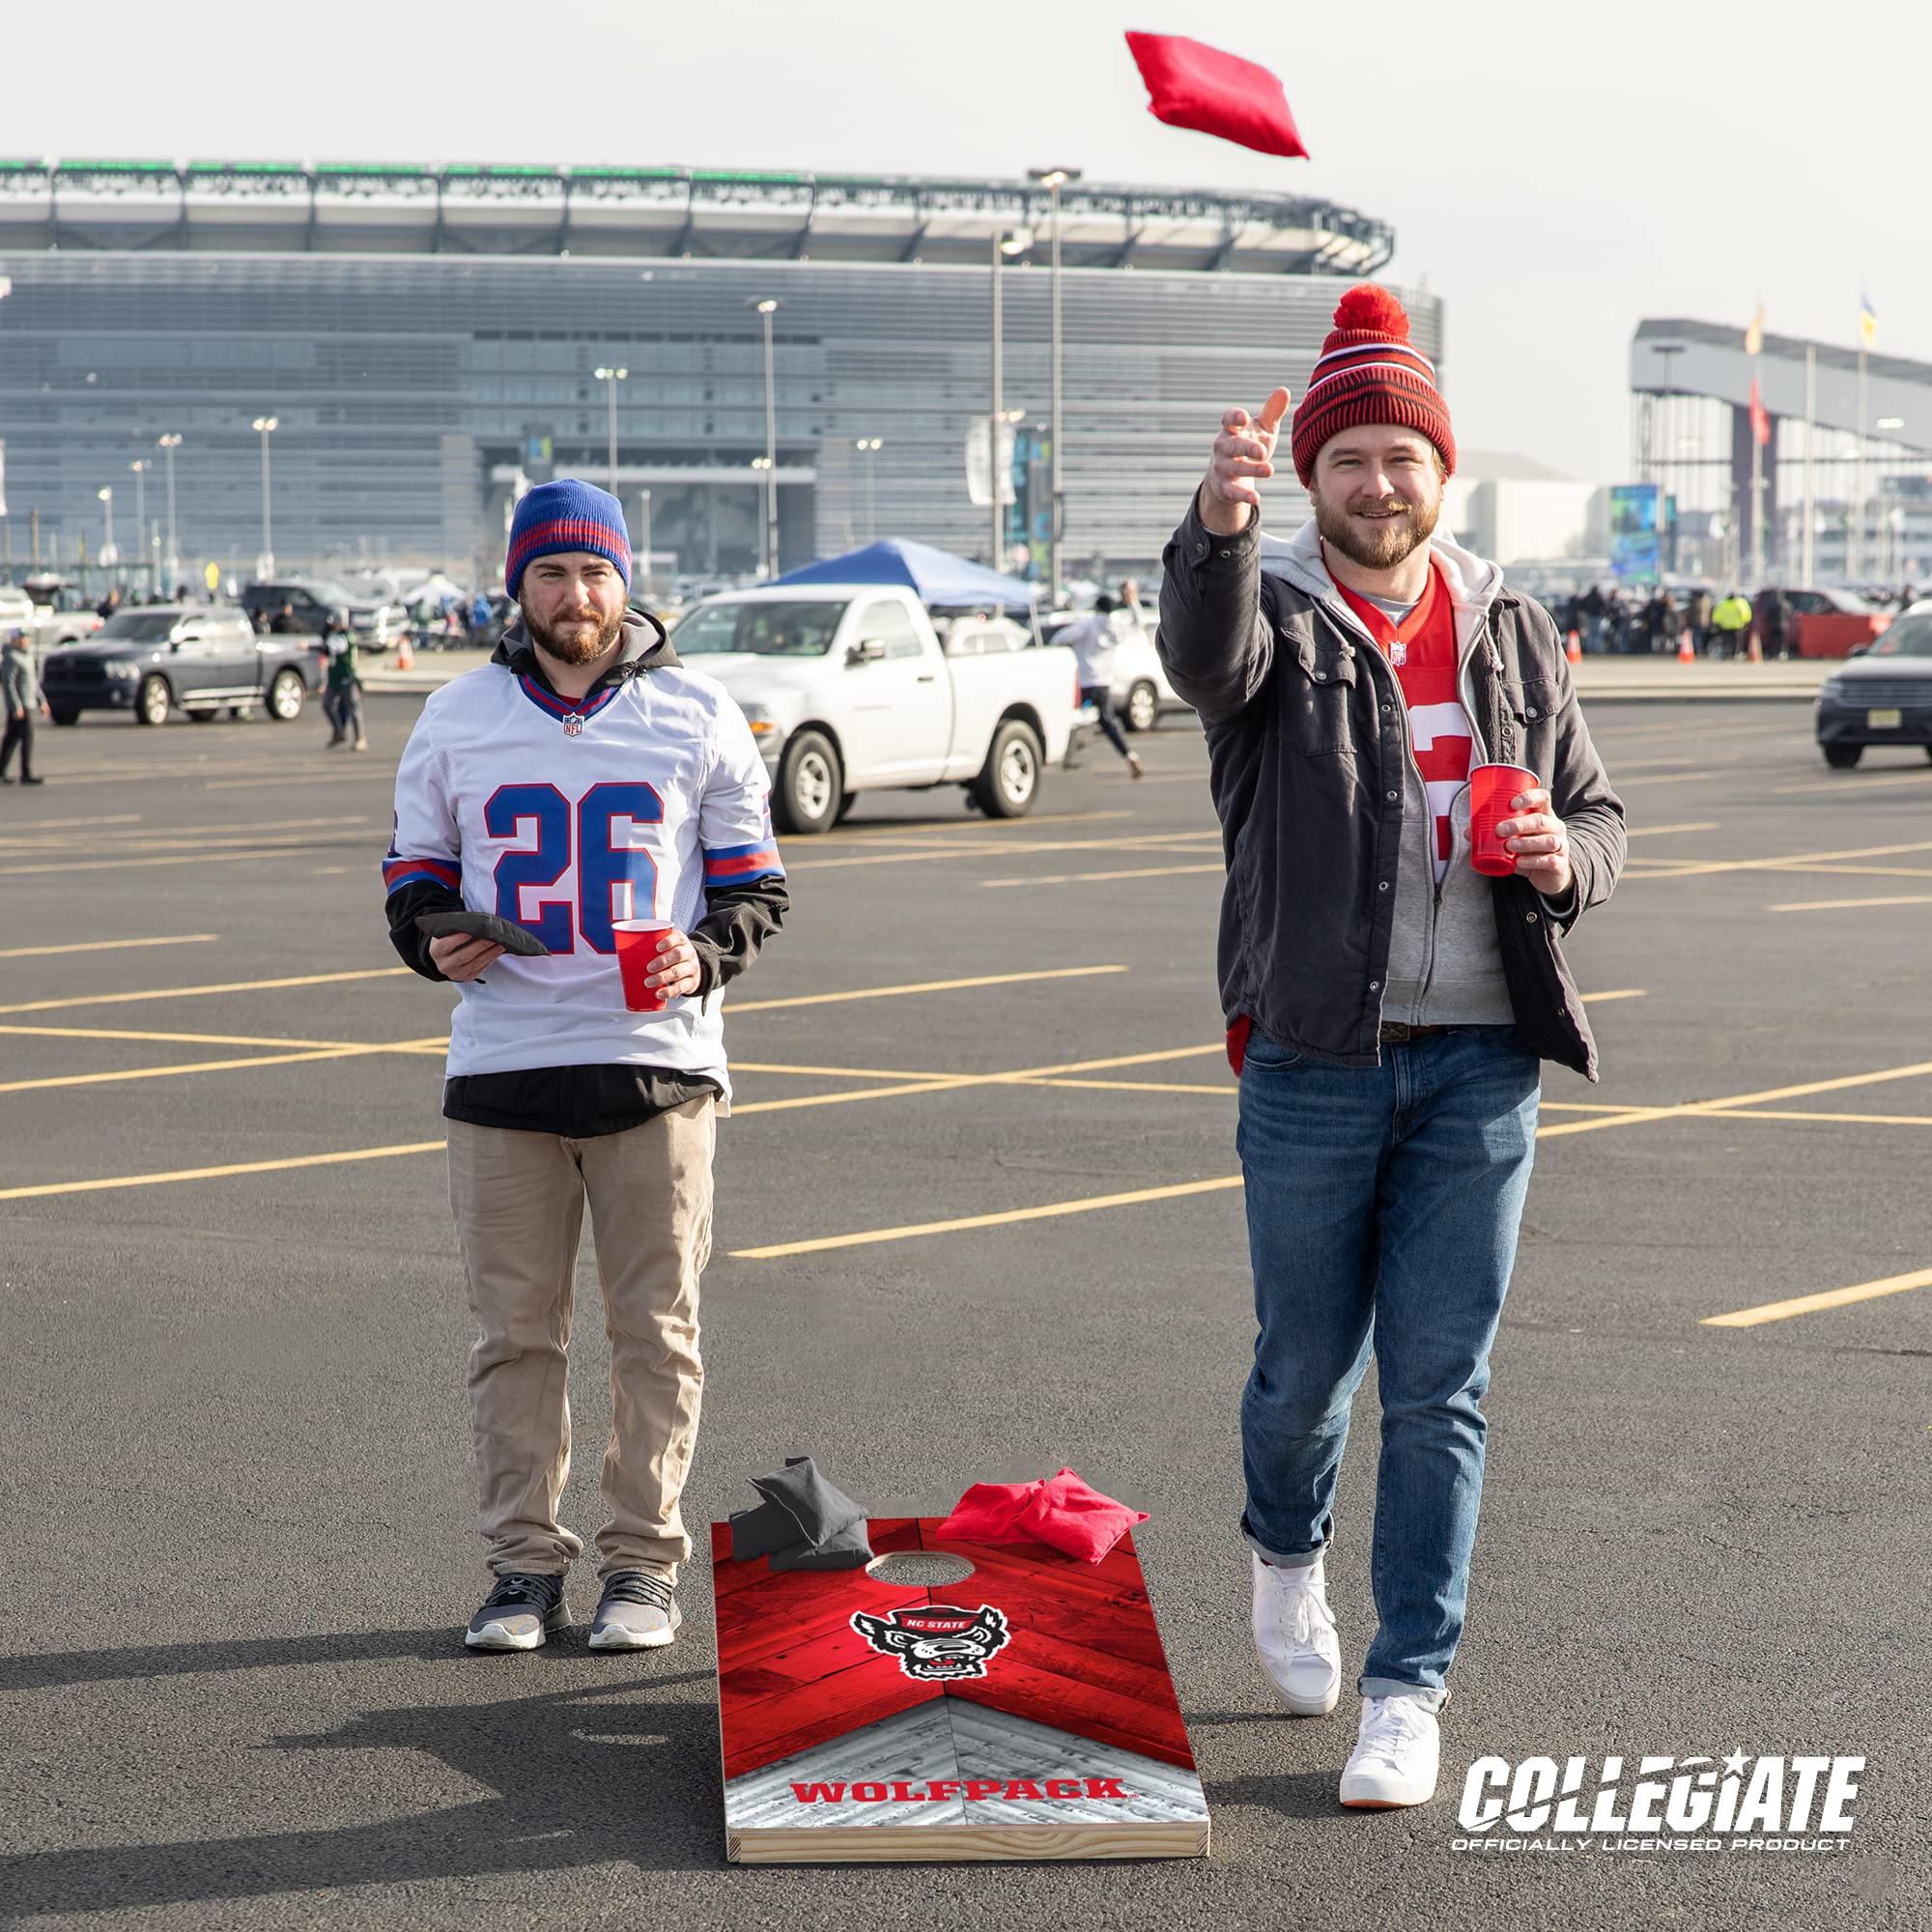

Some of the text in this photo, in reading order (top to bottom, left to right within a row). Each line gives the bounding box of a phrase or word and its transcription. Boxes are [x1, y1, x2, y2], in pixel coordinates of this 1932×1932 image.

[565, 724, 581, 734] NFL
[483, 781, 665, 955] 26
[906, 1619, 967, 1630] NC STATE
[789, 1778, 1128, 1804] WOLFPACK
